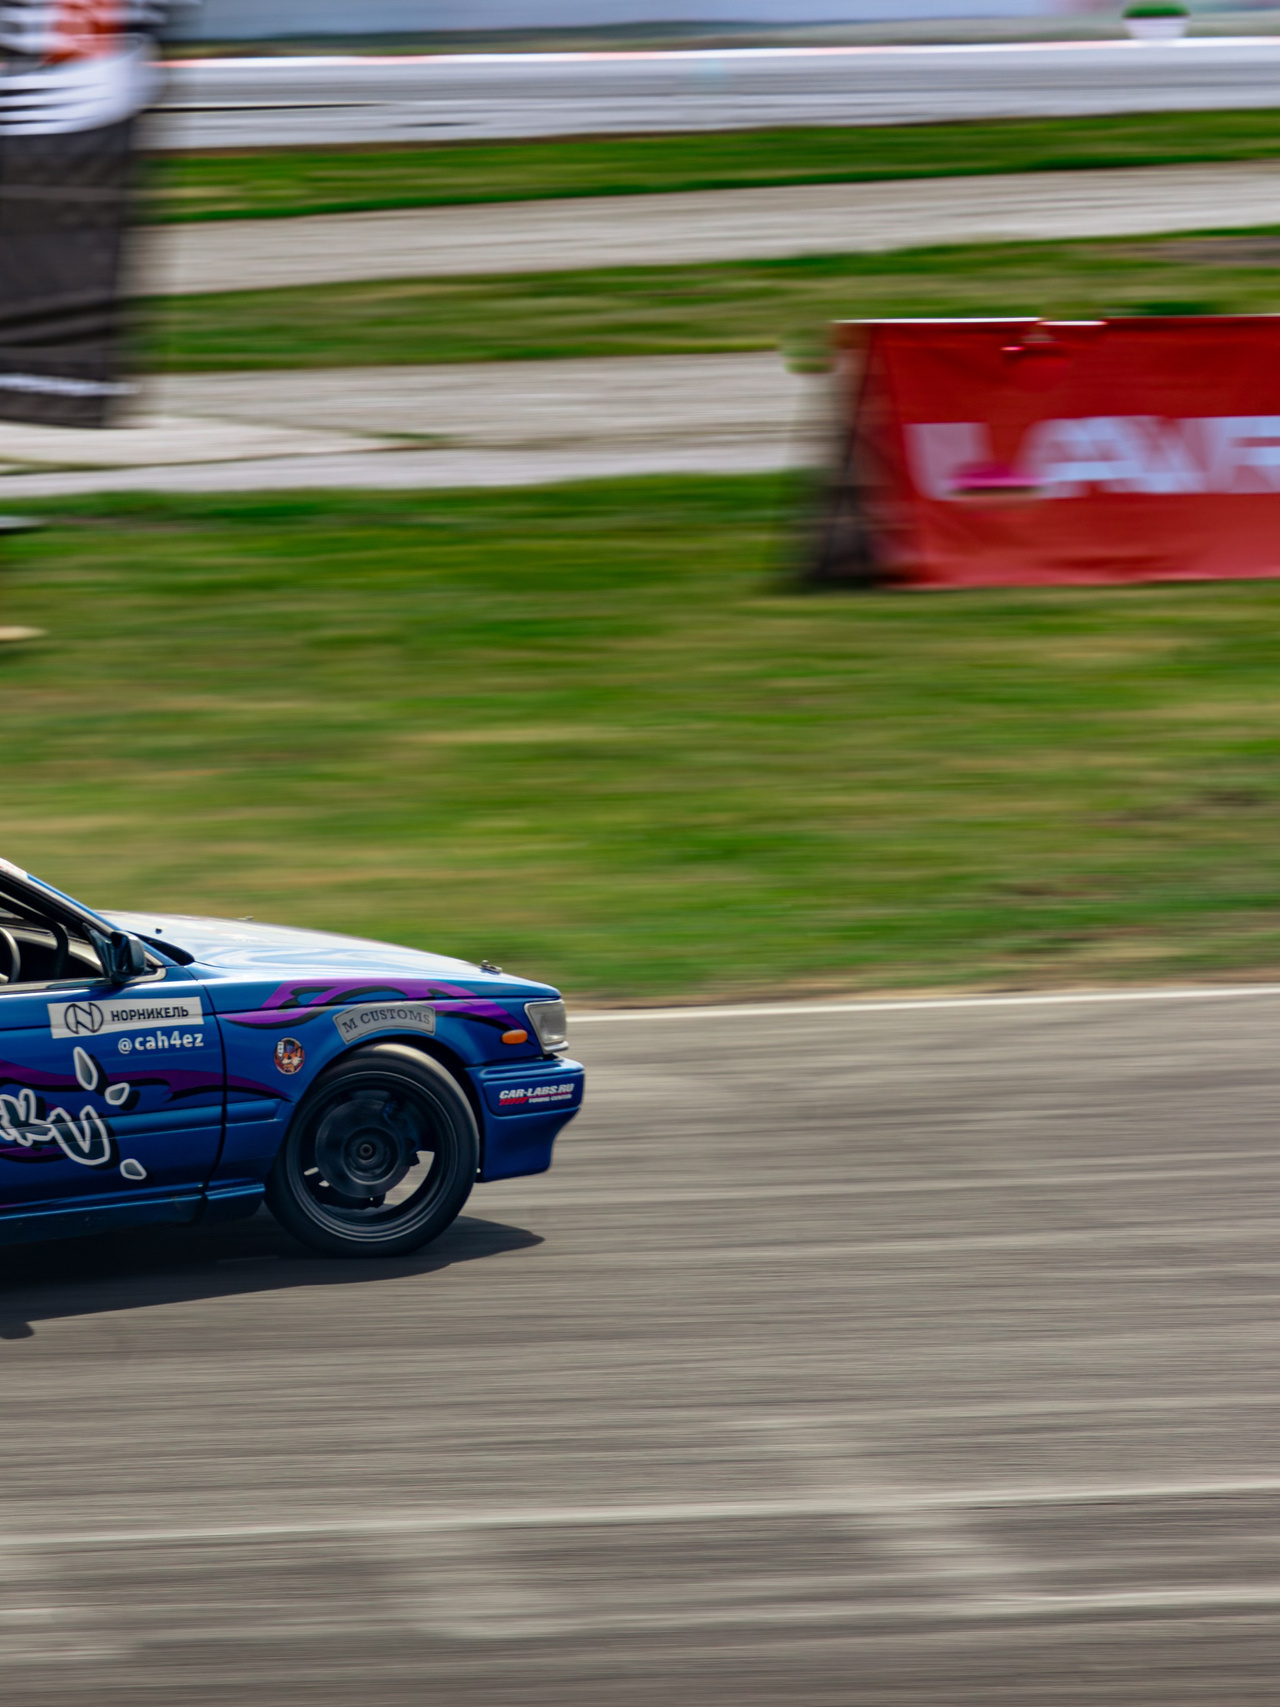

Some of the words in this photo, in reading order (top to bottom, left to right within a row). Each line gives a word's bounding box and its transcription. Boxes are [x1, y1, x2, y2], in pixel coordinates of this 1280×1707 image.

[111, 1006, 189, 1022] НОРНИКЕЛЬ
[342, 1018, 357, 1034] M
[360, 1008, 431, 1026] CUSTOMS
[118, 1030, 204, 1054] @cah4ez
[499, 1083, 575, 1099] CAR-LABS.RU
